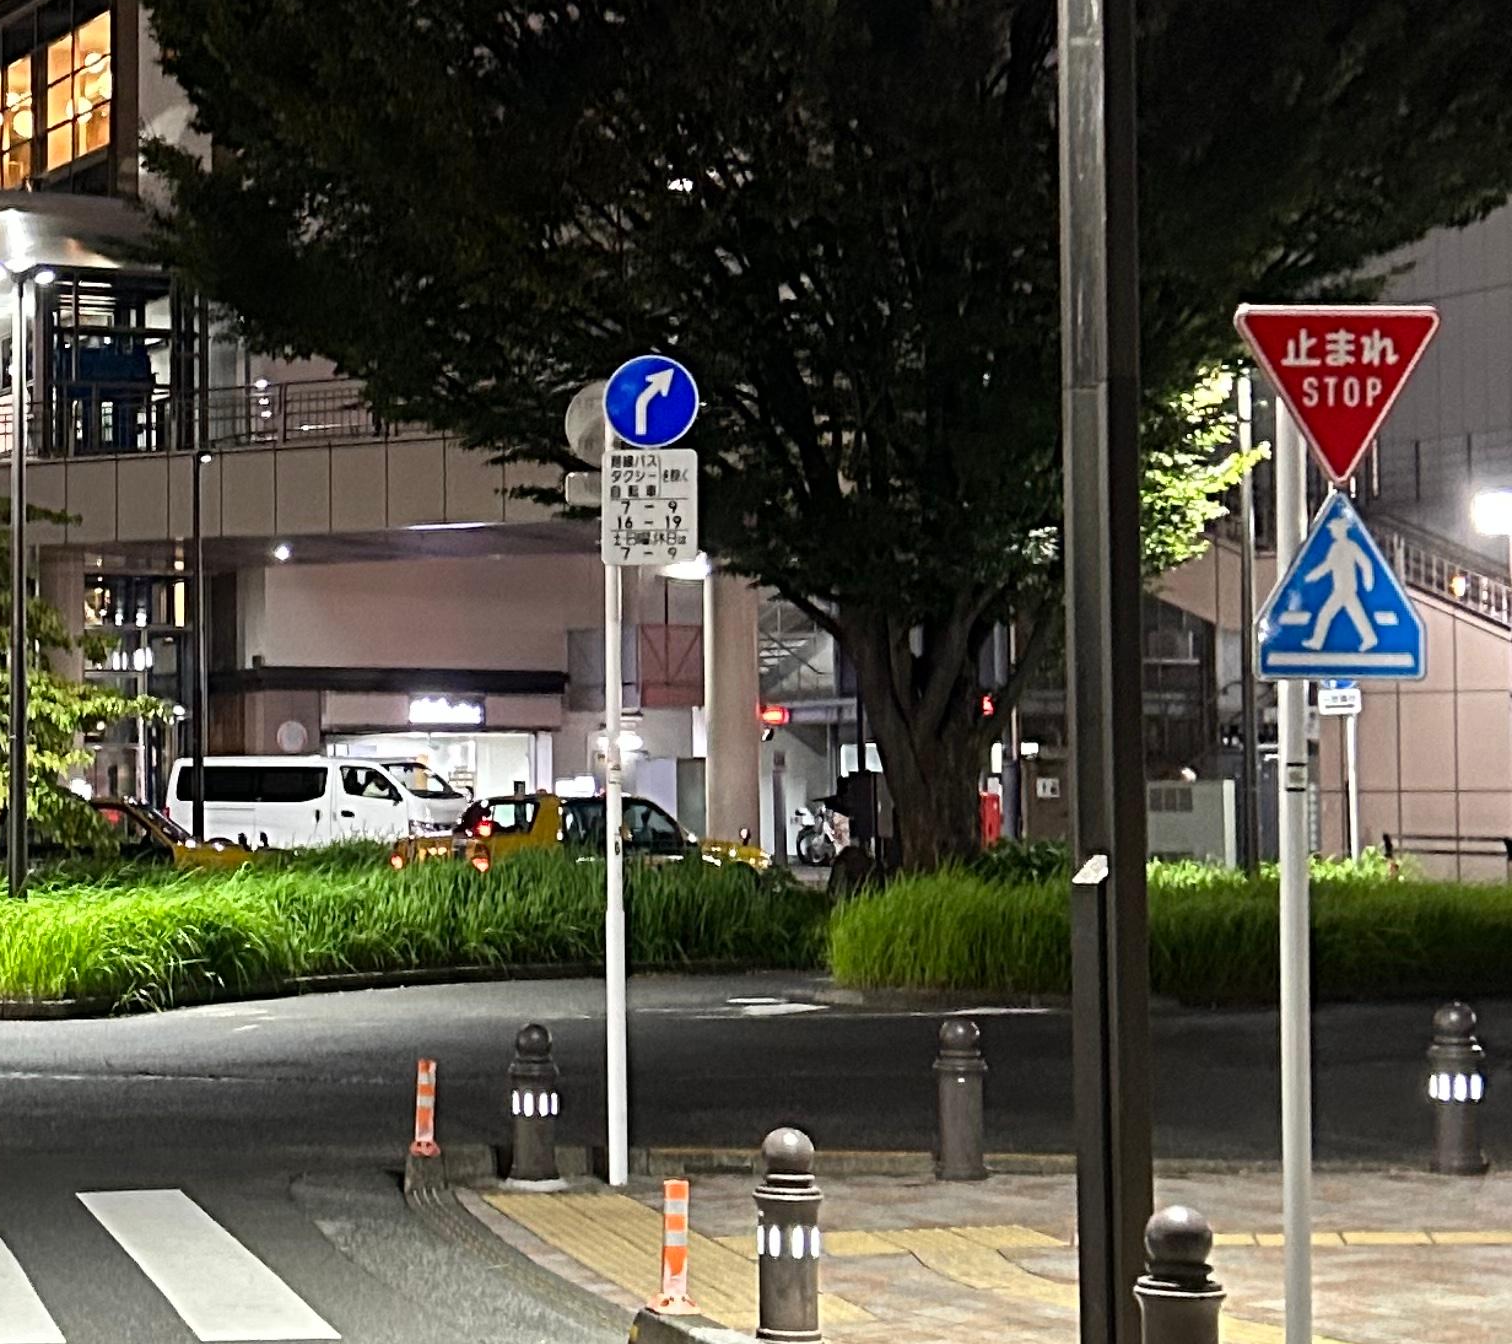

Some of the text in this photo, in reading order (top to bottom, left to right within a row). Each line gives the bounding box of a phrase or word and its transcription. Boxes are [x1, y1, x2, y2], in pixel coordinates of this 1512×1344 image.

[1280, 328, 1400, 367] 止まれ
[1302, 376, 1383, 408] STOP
[610, 470, 657, 484] タクシー
